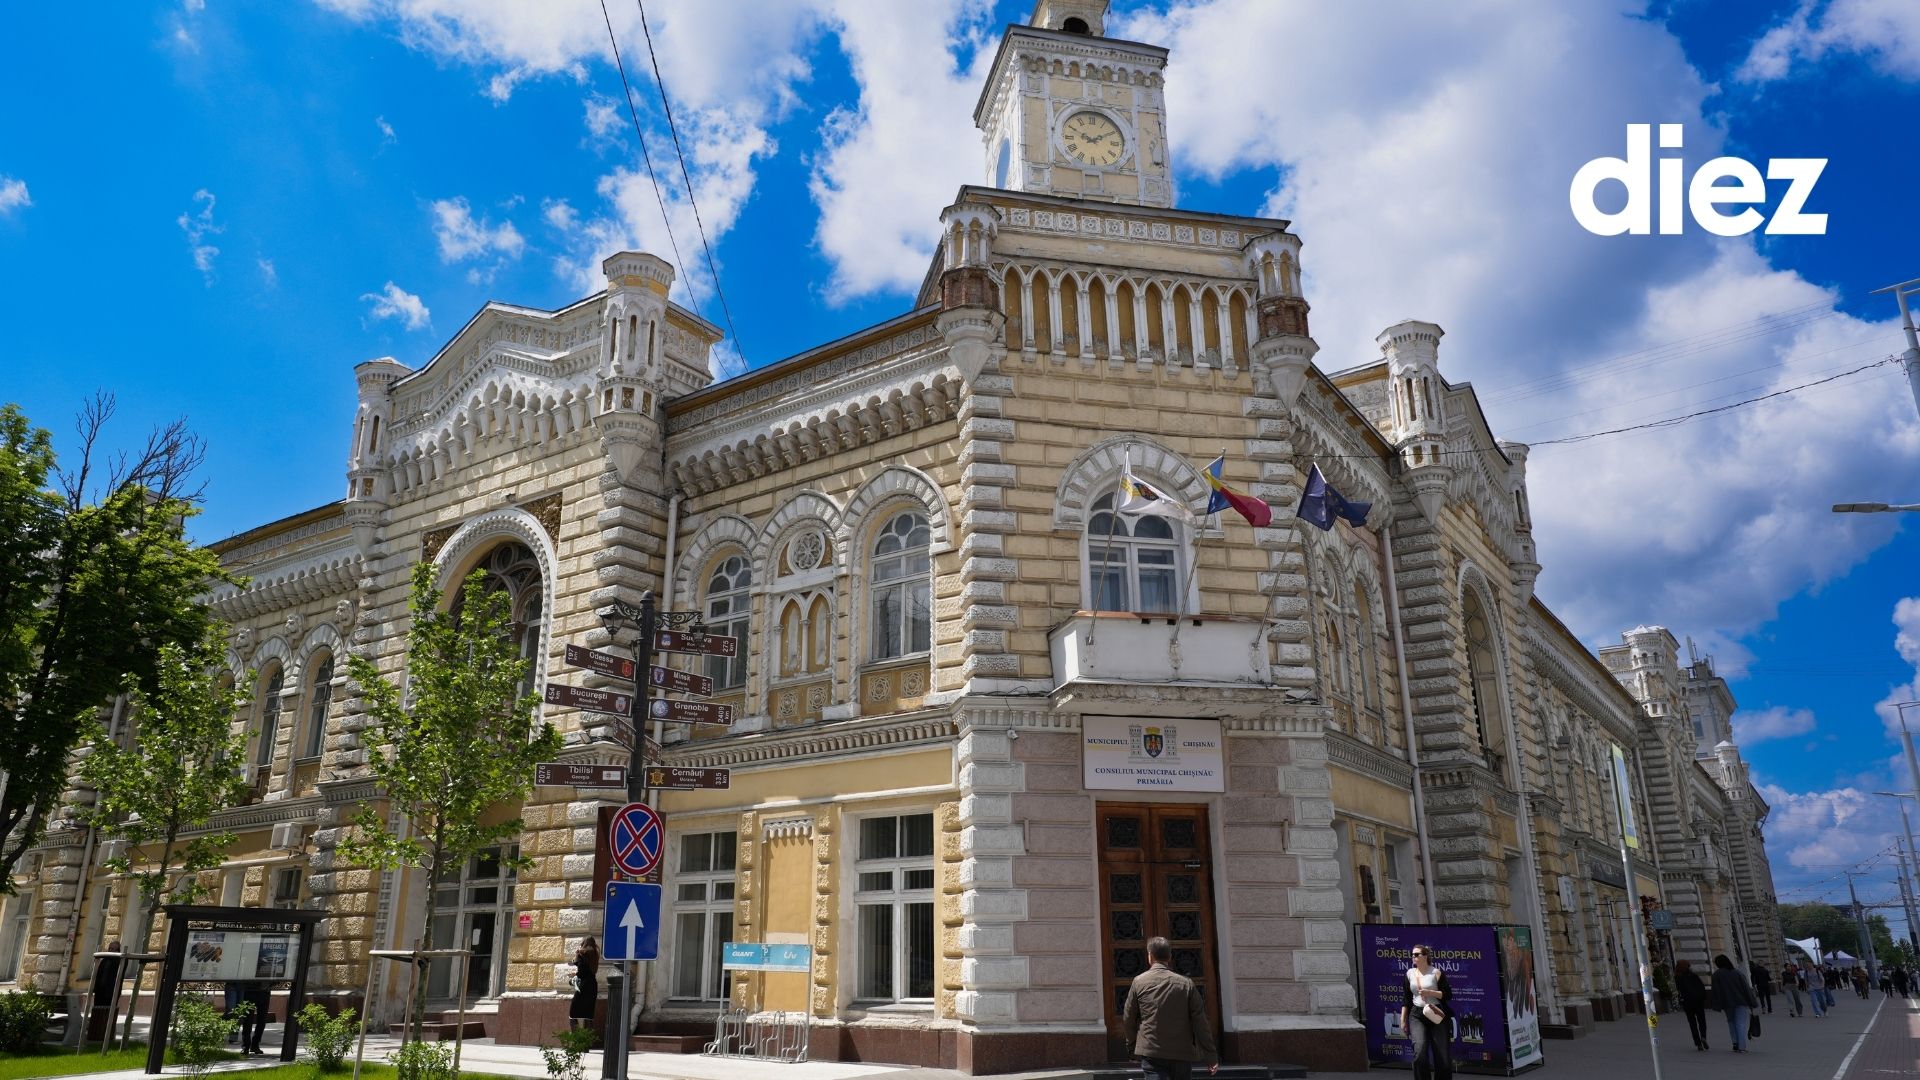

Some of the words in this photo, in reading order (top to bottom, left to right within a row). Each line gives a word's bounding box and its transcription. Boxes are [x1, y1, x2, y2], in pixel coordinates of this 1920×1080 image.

[589, 651, 614, 663] Odessa
[673, 671, 691, 682] Minsk
[570, 688, 608, 700] București
[674, 702, 709, 712] Grenoble
[1182, 740, 1216, 748] CHIȘINĂU
[569, 766, 593, 774] Tbilisi
[672, 769, 705, 779] Cernăuți
[1095, 767, 1136, 775] CONSILIUL
[1178, 769, 1214, 778] CHIȘINĂU
[1398, 960, 1409, 971] ÎN
